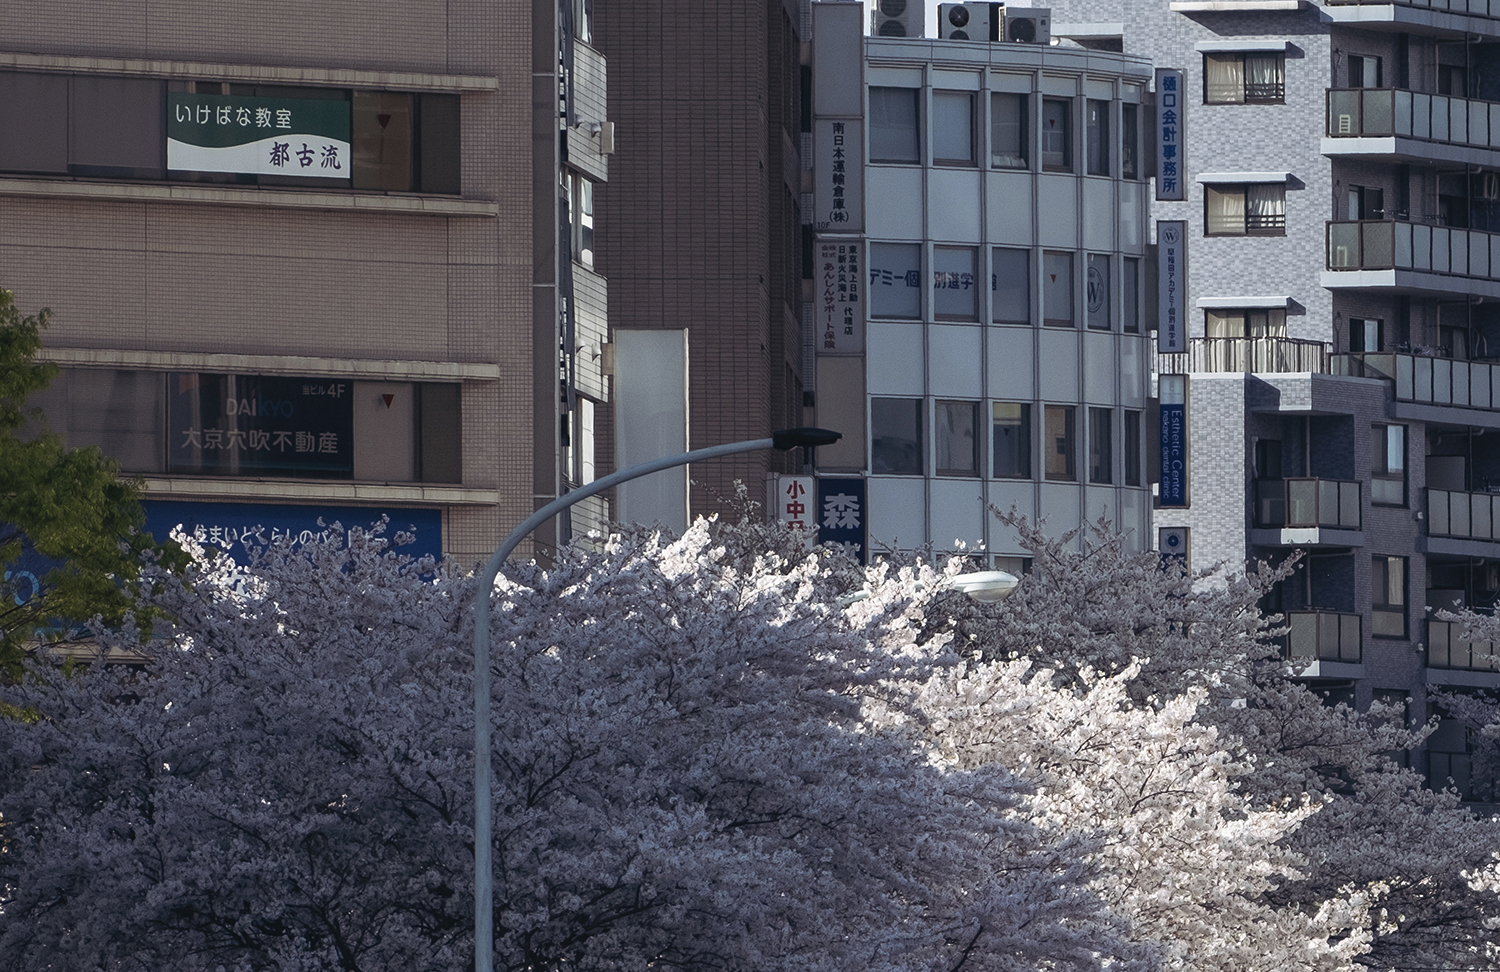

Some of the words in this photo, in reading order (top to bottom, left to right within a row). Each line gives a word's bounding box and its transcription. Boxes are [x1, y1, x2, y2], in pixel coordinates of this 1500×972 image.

[175, 104, 292, 129] いけばな教室
[1162, 76, 1177, 193] 樋口会計事務所
[269, 141, 342, 170] 都古流
[848, 245, 858, 303] 東京海上日動
[823, 262, 836, 349] あんしんサポート保険
[843, 306, 853, 336] 代理店
[181, 426, 339, 454] 大京穴吹不動産
[1162, 411, 1170, 444] nakano
[1171, 410, 1183, 456] Esthetic
[1162, 446, 1170, 474] dental
[1162, 476, 1171, 499] clinic
[1171, 460, 1183, 499] Center
